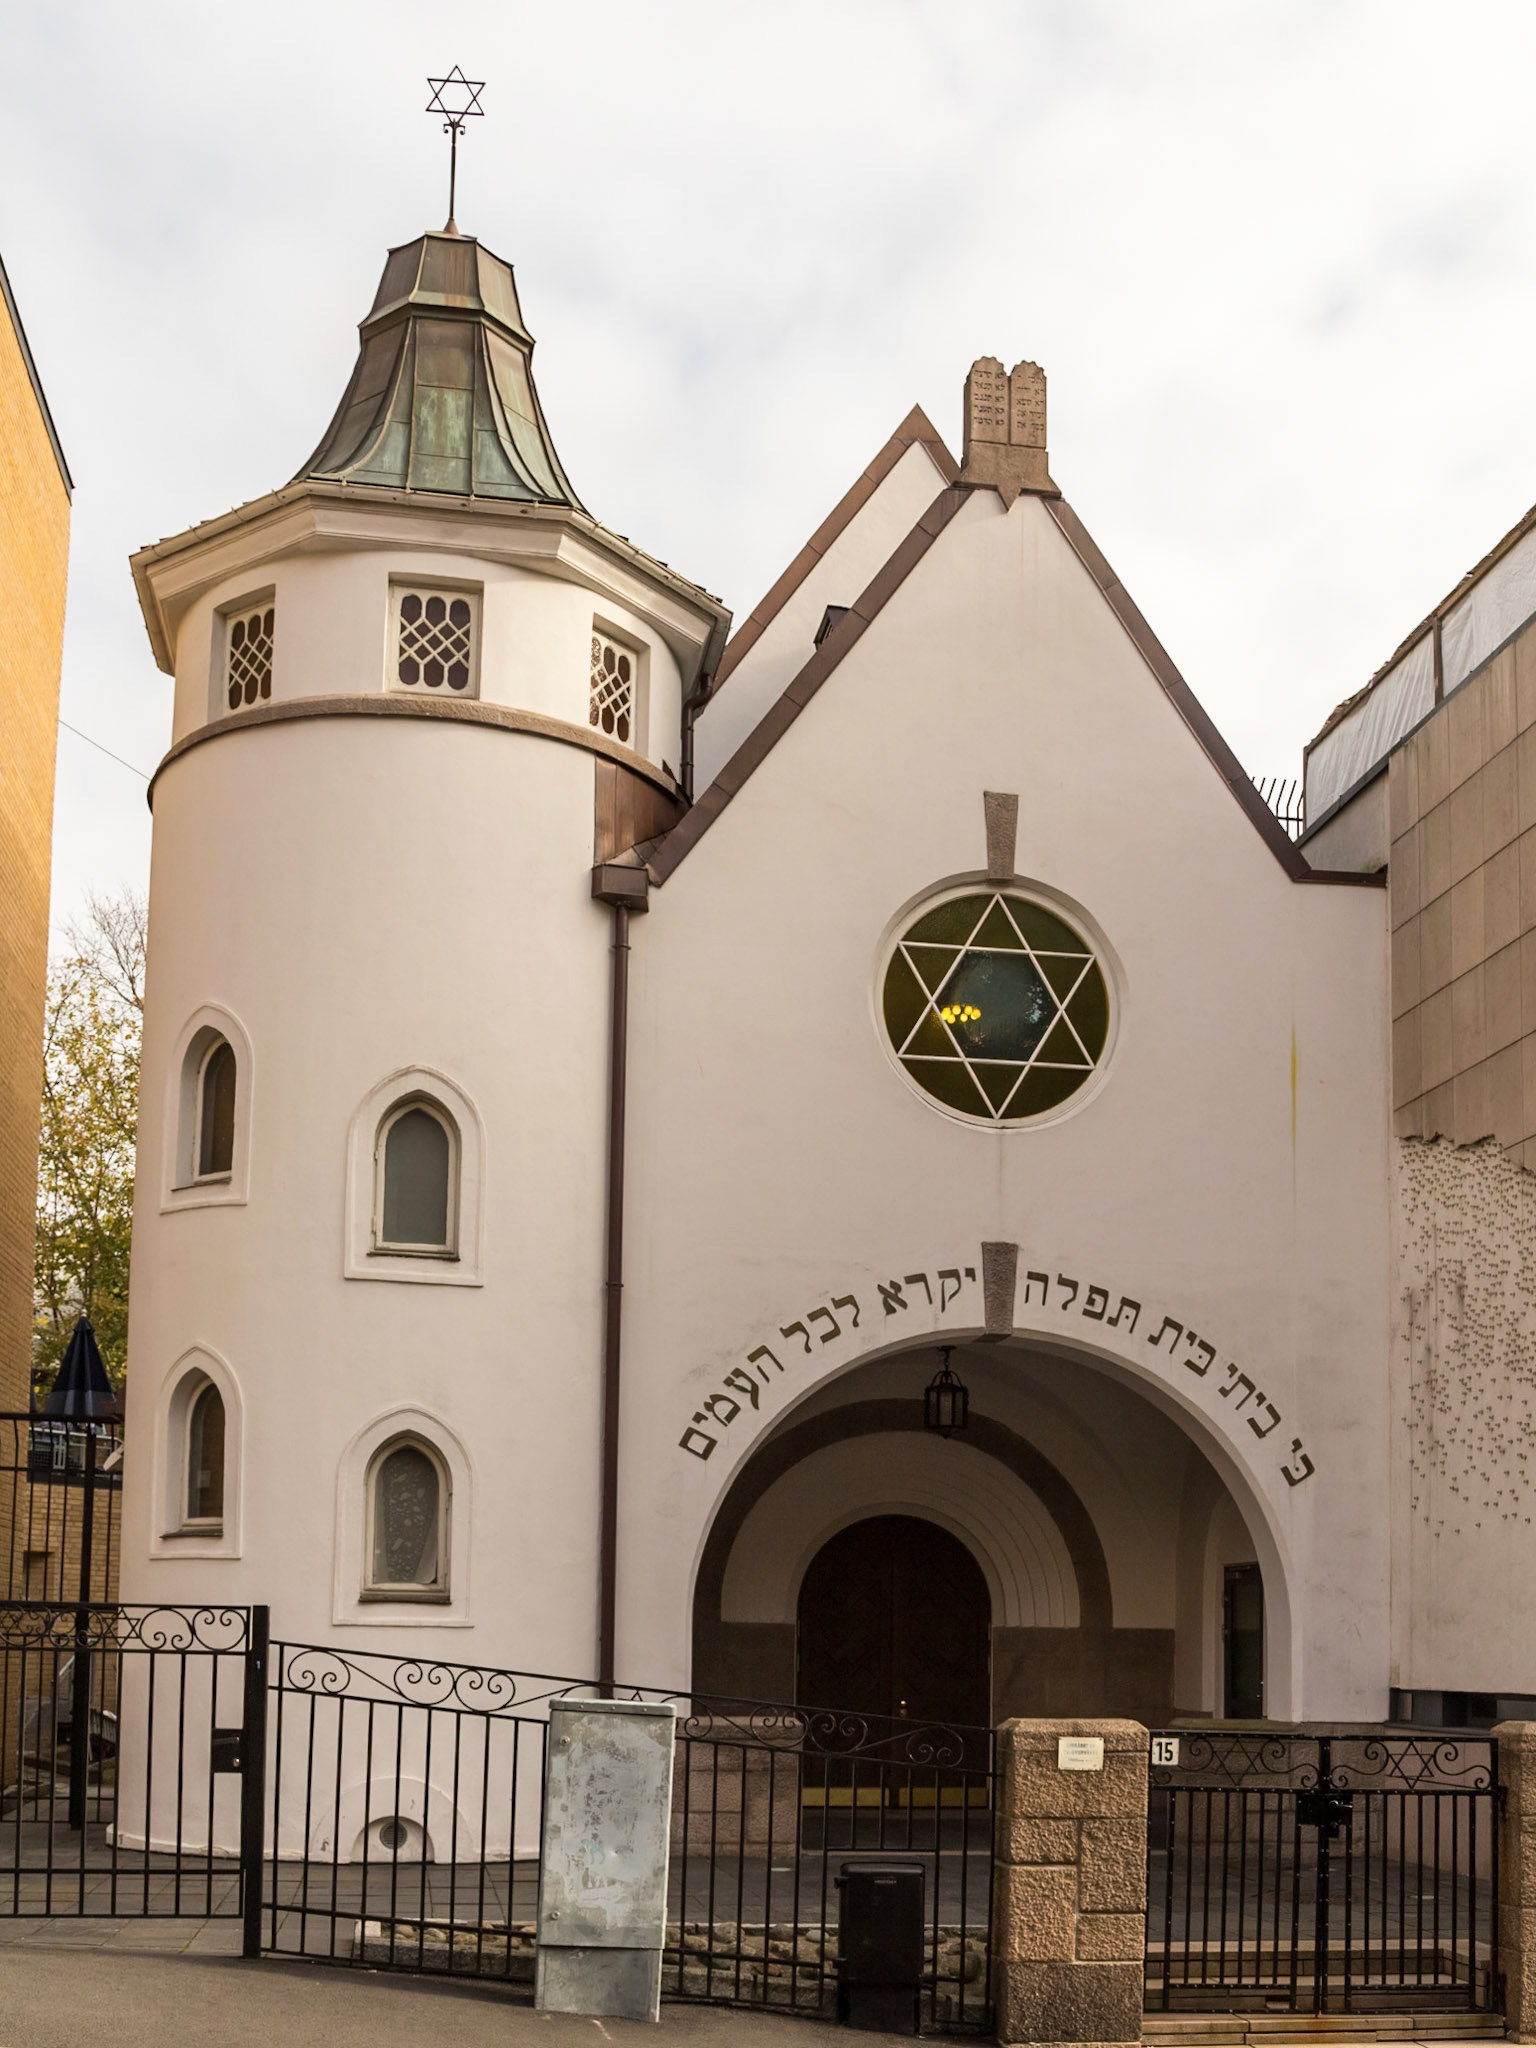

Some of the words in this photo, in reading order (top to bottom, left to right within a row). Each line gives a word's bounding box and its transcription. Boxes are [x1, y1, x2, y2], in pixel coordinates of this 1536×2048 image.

[877, 1267, 976, 1316] יקרא
[779, 1294, 859, 1353] לכל
[678, 1345, 785, 1461] העמים
[1156, 1741, 1173, 1762] 15
